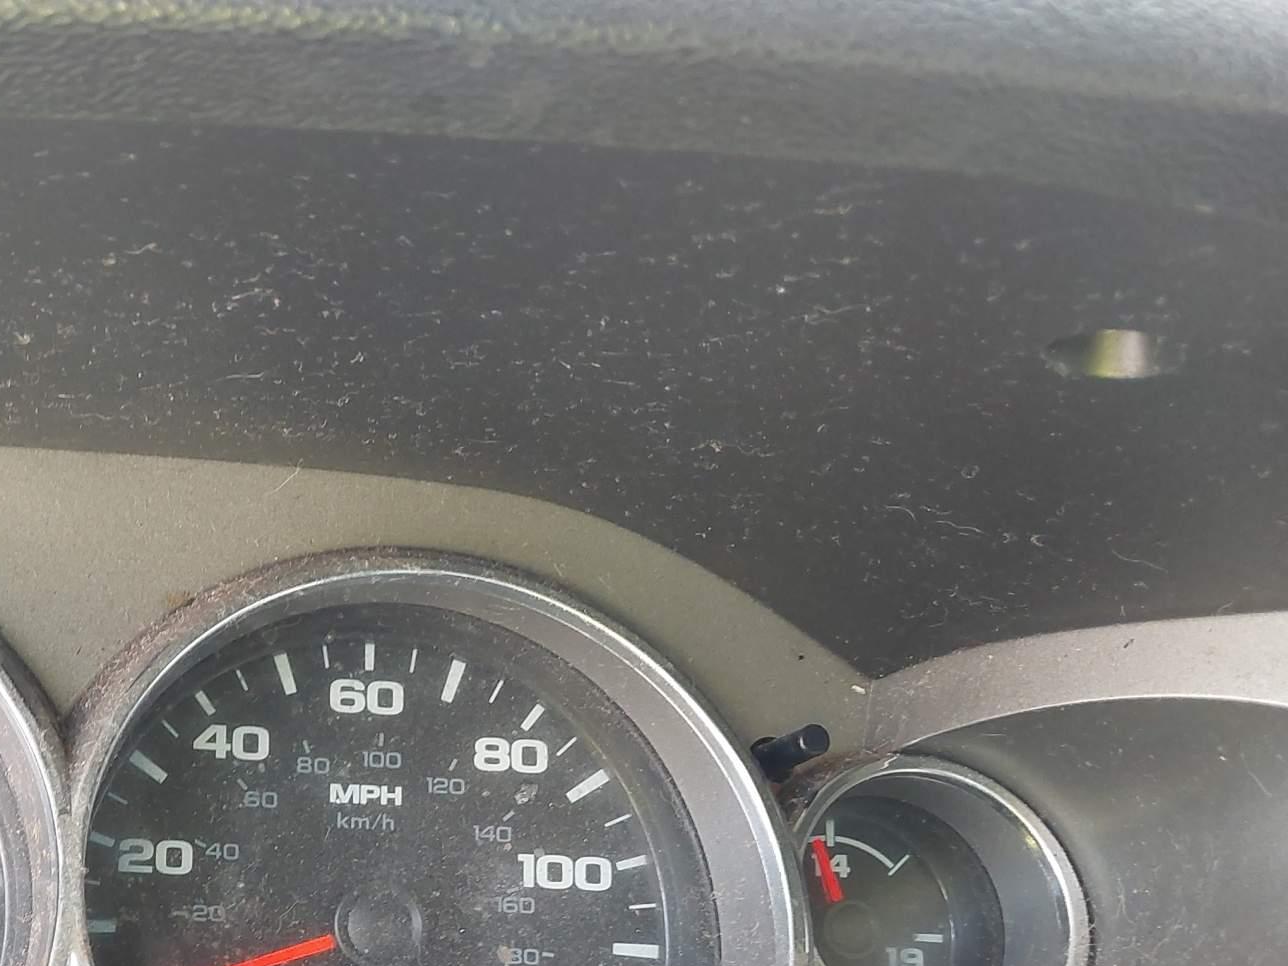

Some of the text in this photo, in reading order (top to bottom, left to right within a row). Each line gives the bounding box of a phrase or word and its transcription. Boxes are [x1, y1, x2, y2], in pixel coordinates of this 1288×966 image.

[329, 679, 405, 716] 60
[192, 725, 270, 761] 40
[297, 757, 330, 775] 80
[362, 751, 402, 770] 100
[473, 738, 549, 774] 80
[328, 784, 403, 807] MPH
[426, 777, 466, 796] 120
[244, 791, 279, 809] 60
[336, 811, 396, 832] km/h
[473, 824, 512, 844] 140
[118, 838, 193, 875] 20
[205, 843, 239, 860] 40
[517, 853, 612, 891] 100
[497, 897, 535, 914] 160
